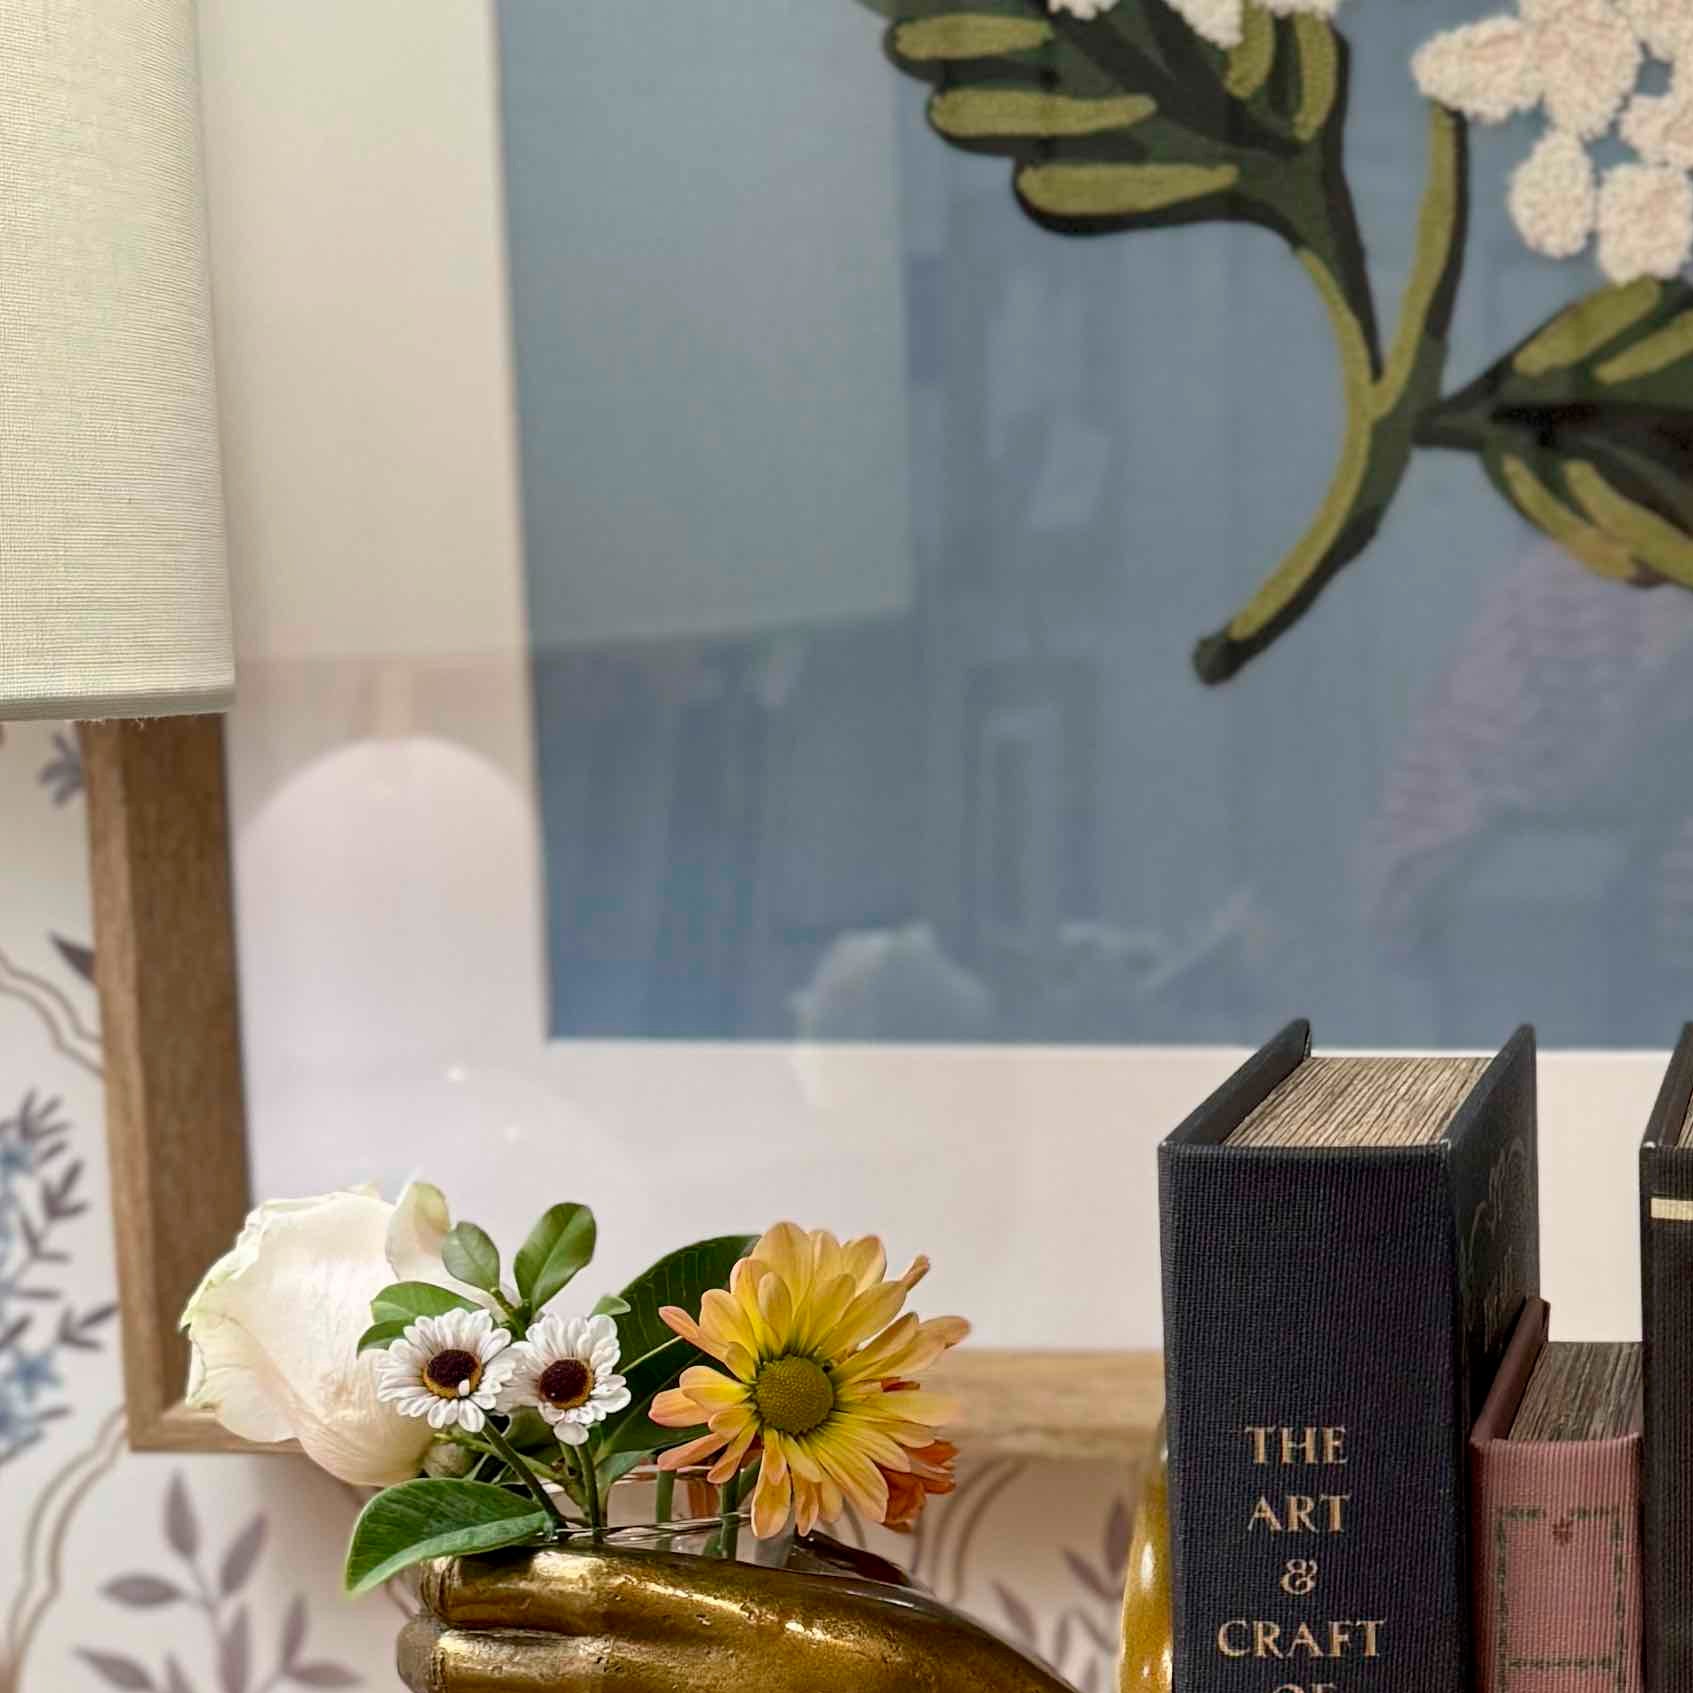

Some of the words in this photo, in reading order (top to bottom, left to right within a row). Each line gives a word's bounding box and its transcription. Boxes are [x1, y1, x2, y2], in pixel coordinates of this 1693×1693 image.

[1244, 1425, 1348, 1464] THE
[1247, 1493, 1351, 1533] ART
[1280, 1558, 1319, 1595] &
[1216, 1619, 1386, 1659] CRAFT
